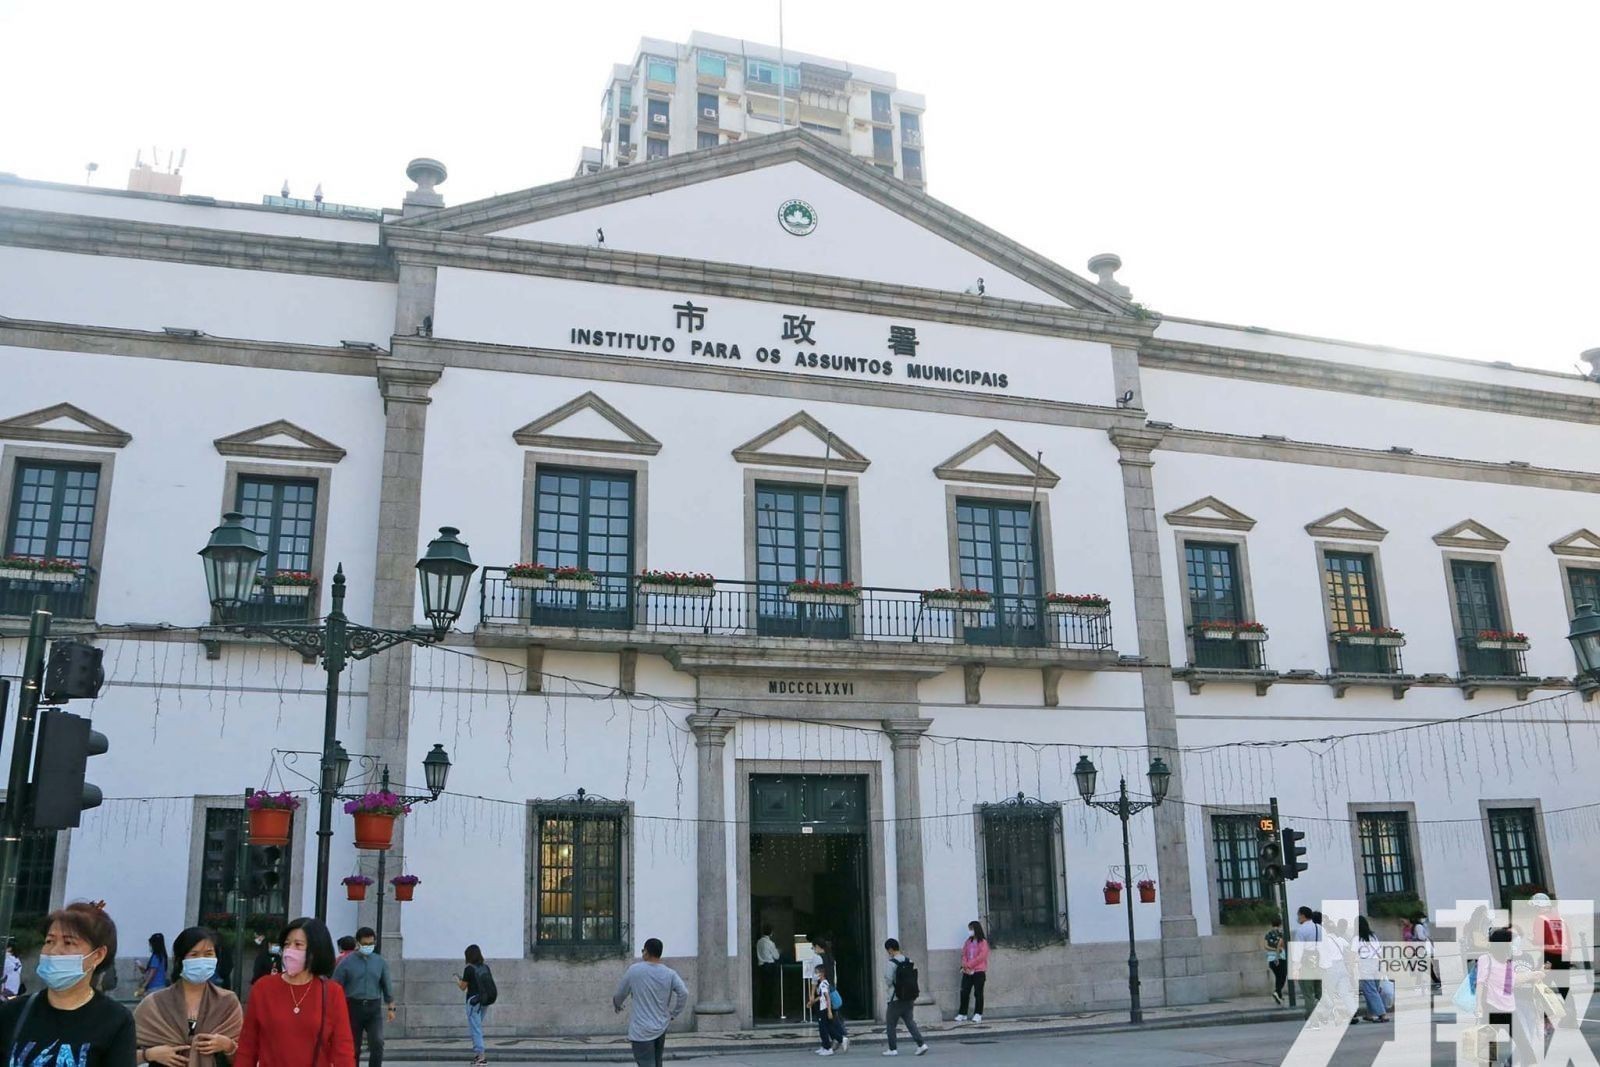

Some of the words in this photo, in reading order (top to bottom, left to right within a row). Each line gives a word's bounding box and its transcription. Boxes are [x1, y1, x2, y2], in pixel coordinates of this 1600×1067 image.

[673, 300, 920, 358] 市政署
[570, 328, 675, 353] INSTITUTO
[691, 340, 742, 361] PARA
[756, 347, 781, 365] OS
[794, 351, 893, 376] ASSUNTOS
[906, 363, 1009, 389] MUNICIPAIS
[768, 680, 854, 696] MDCCCLXXVI
[1260, 819, 1274, 831] 05
